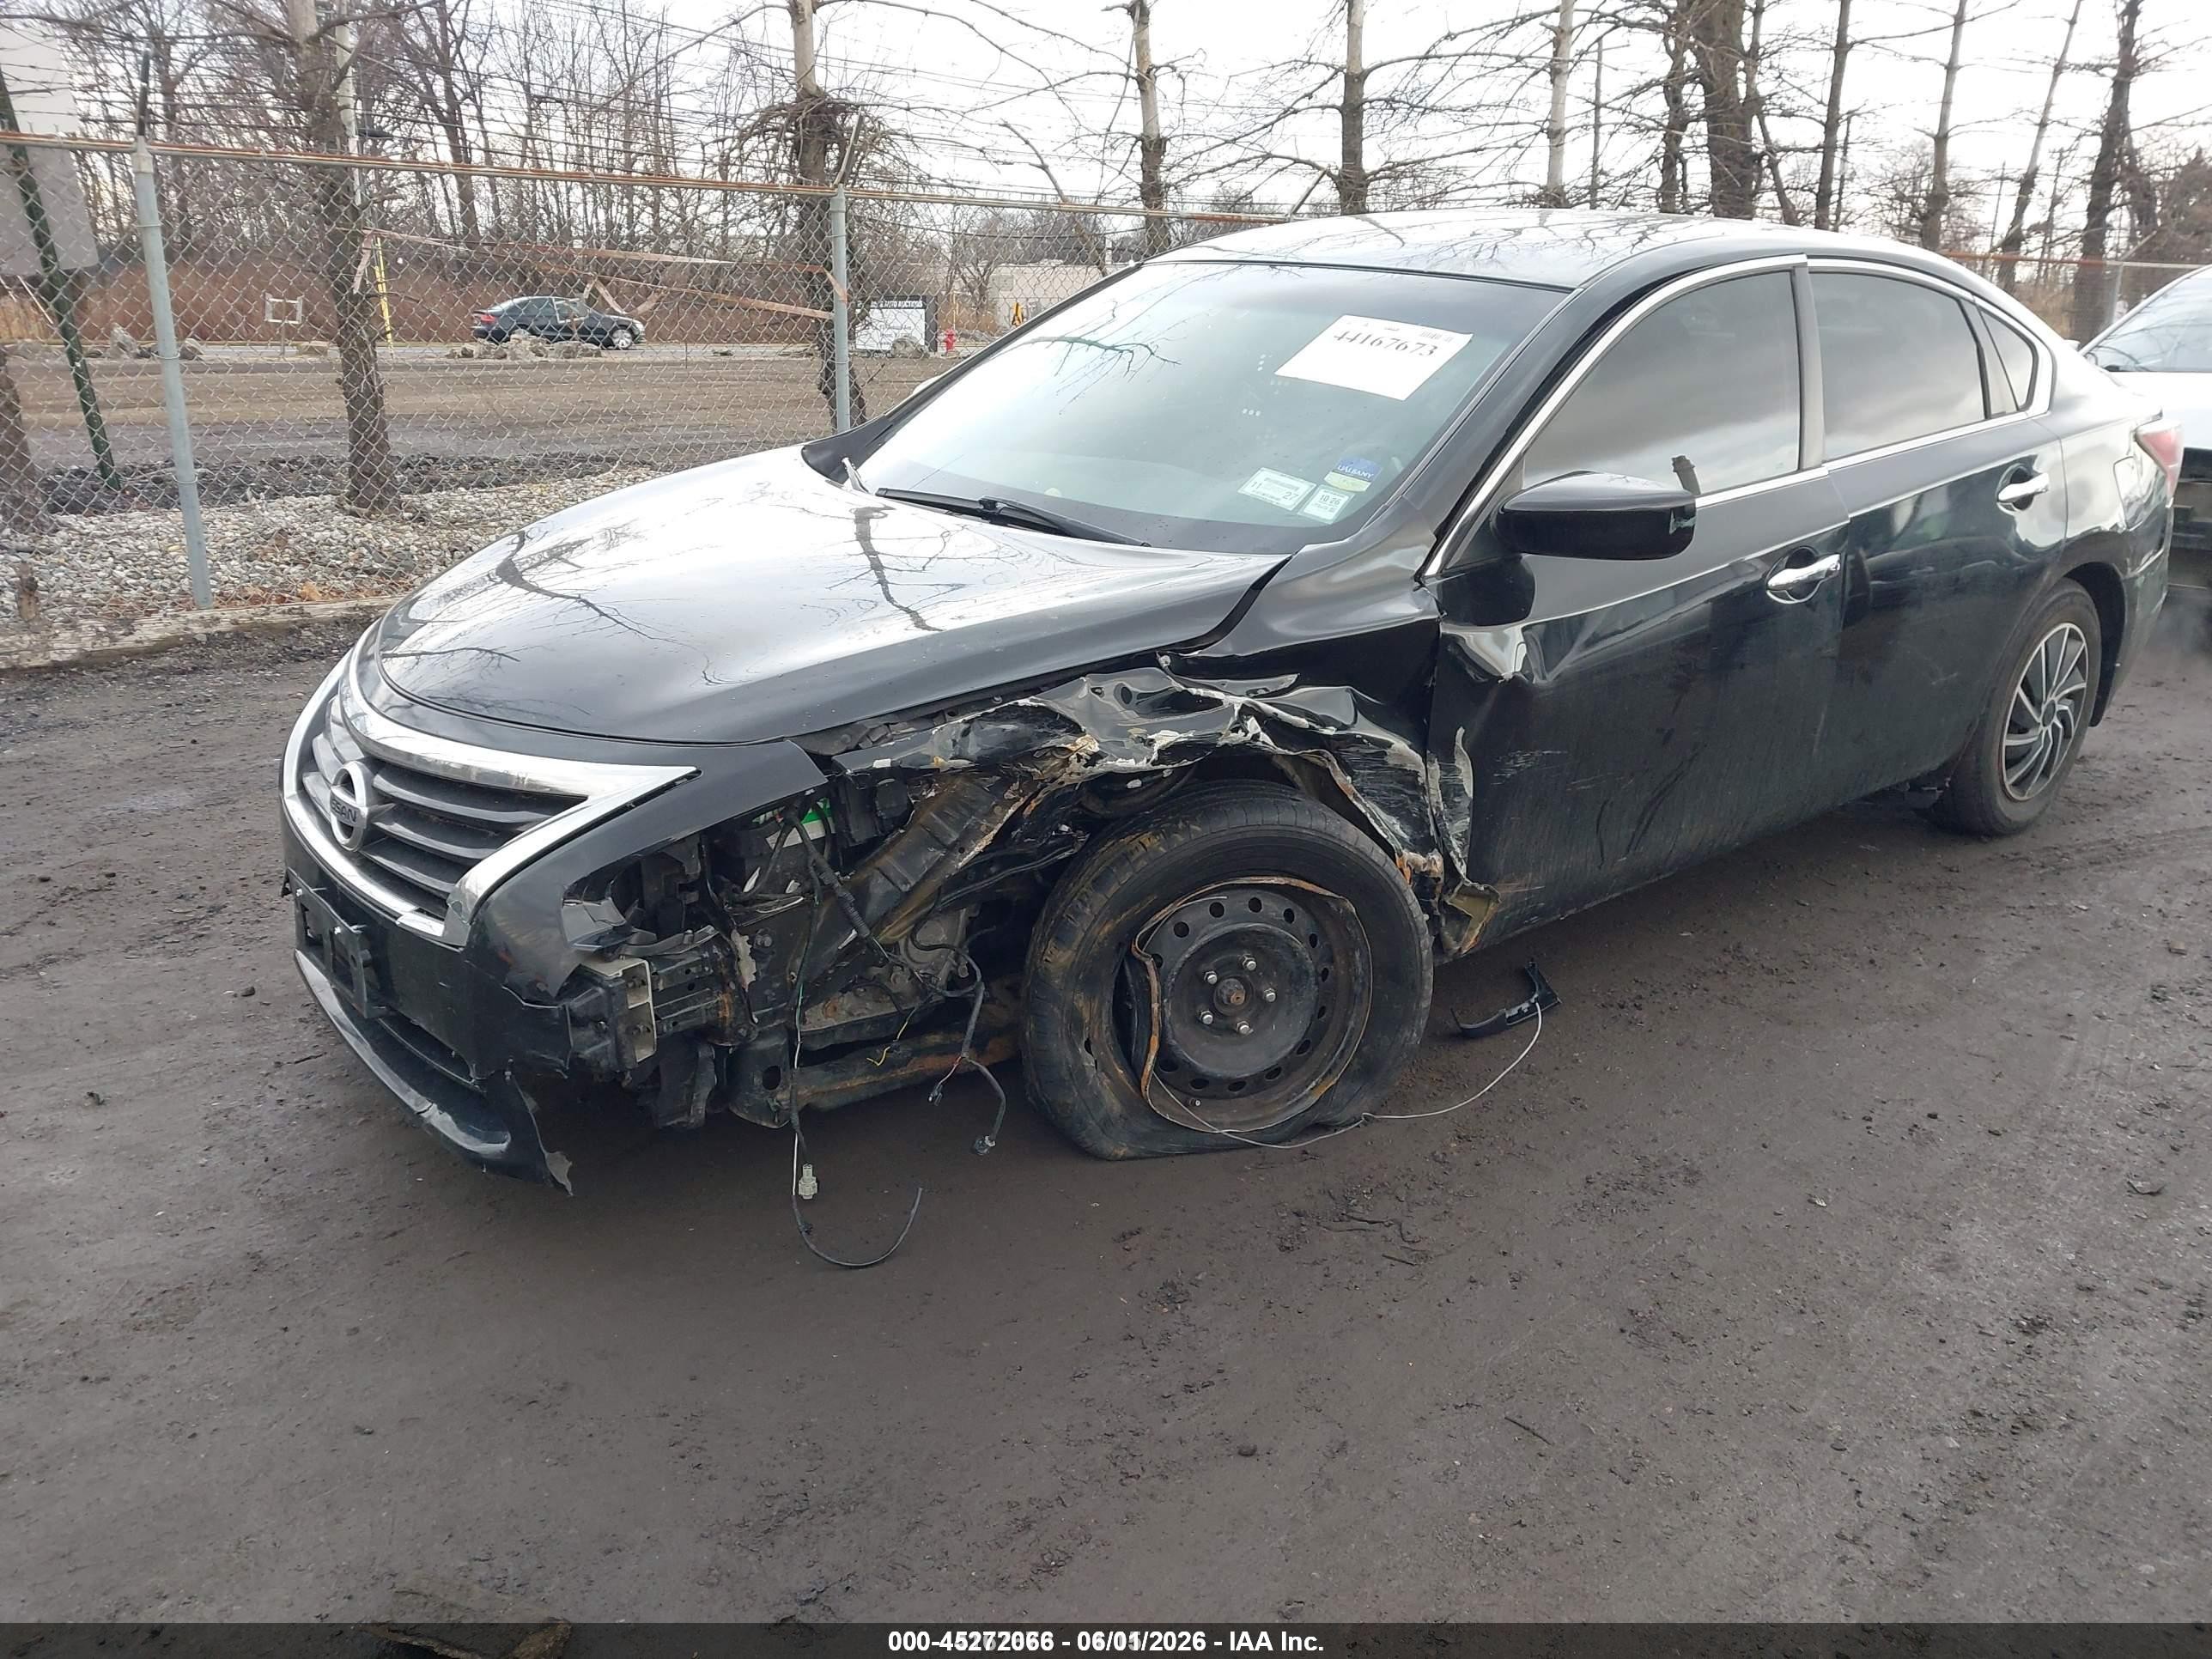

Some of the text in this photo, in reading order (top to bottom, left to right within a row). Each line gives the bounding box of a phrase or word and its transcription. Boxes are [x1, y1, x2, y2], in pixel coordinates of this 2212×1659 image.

[1334, 331, 1438, 356] 44167673
[1282, 490, 1299, 501] 27
[1320, 494, 1330, 502] 10
[1329, 496, 1340, 506] 26
